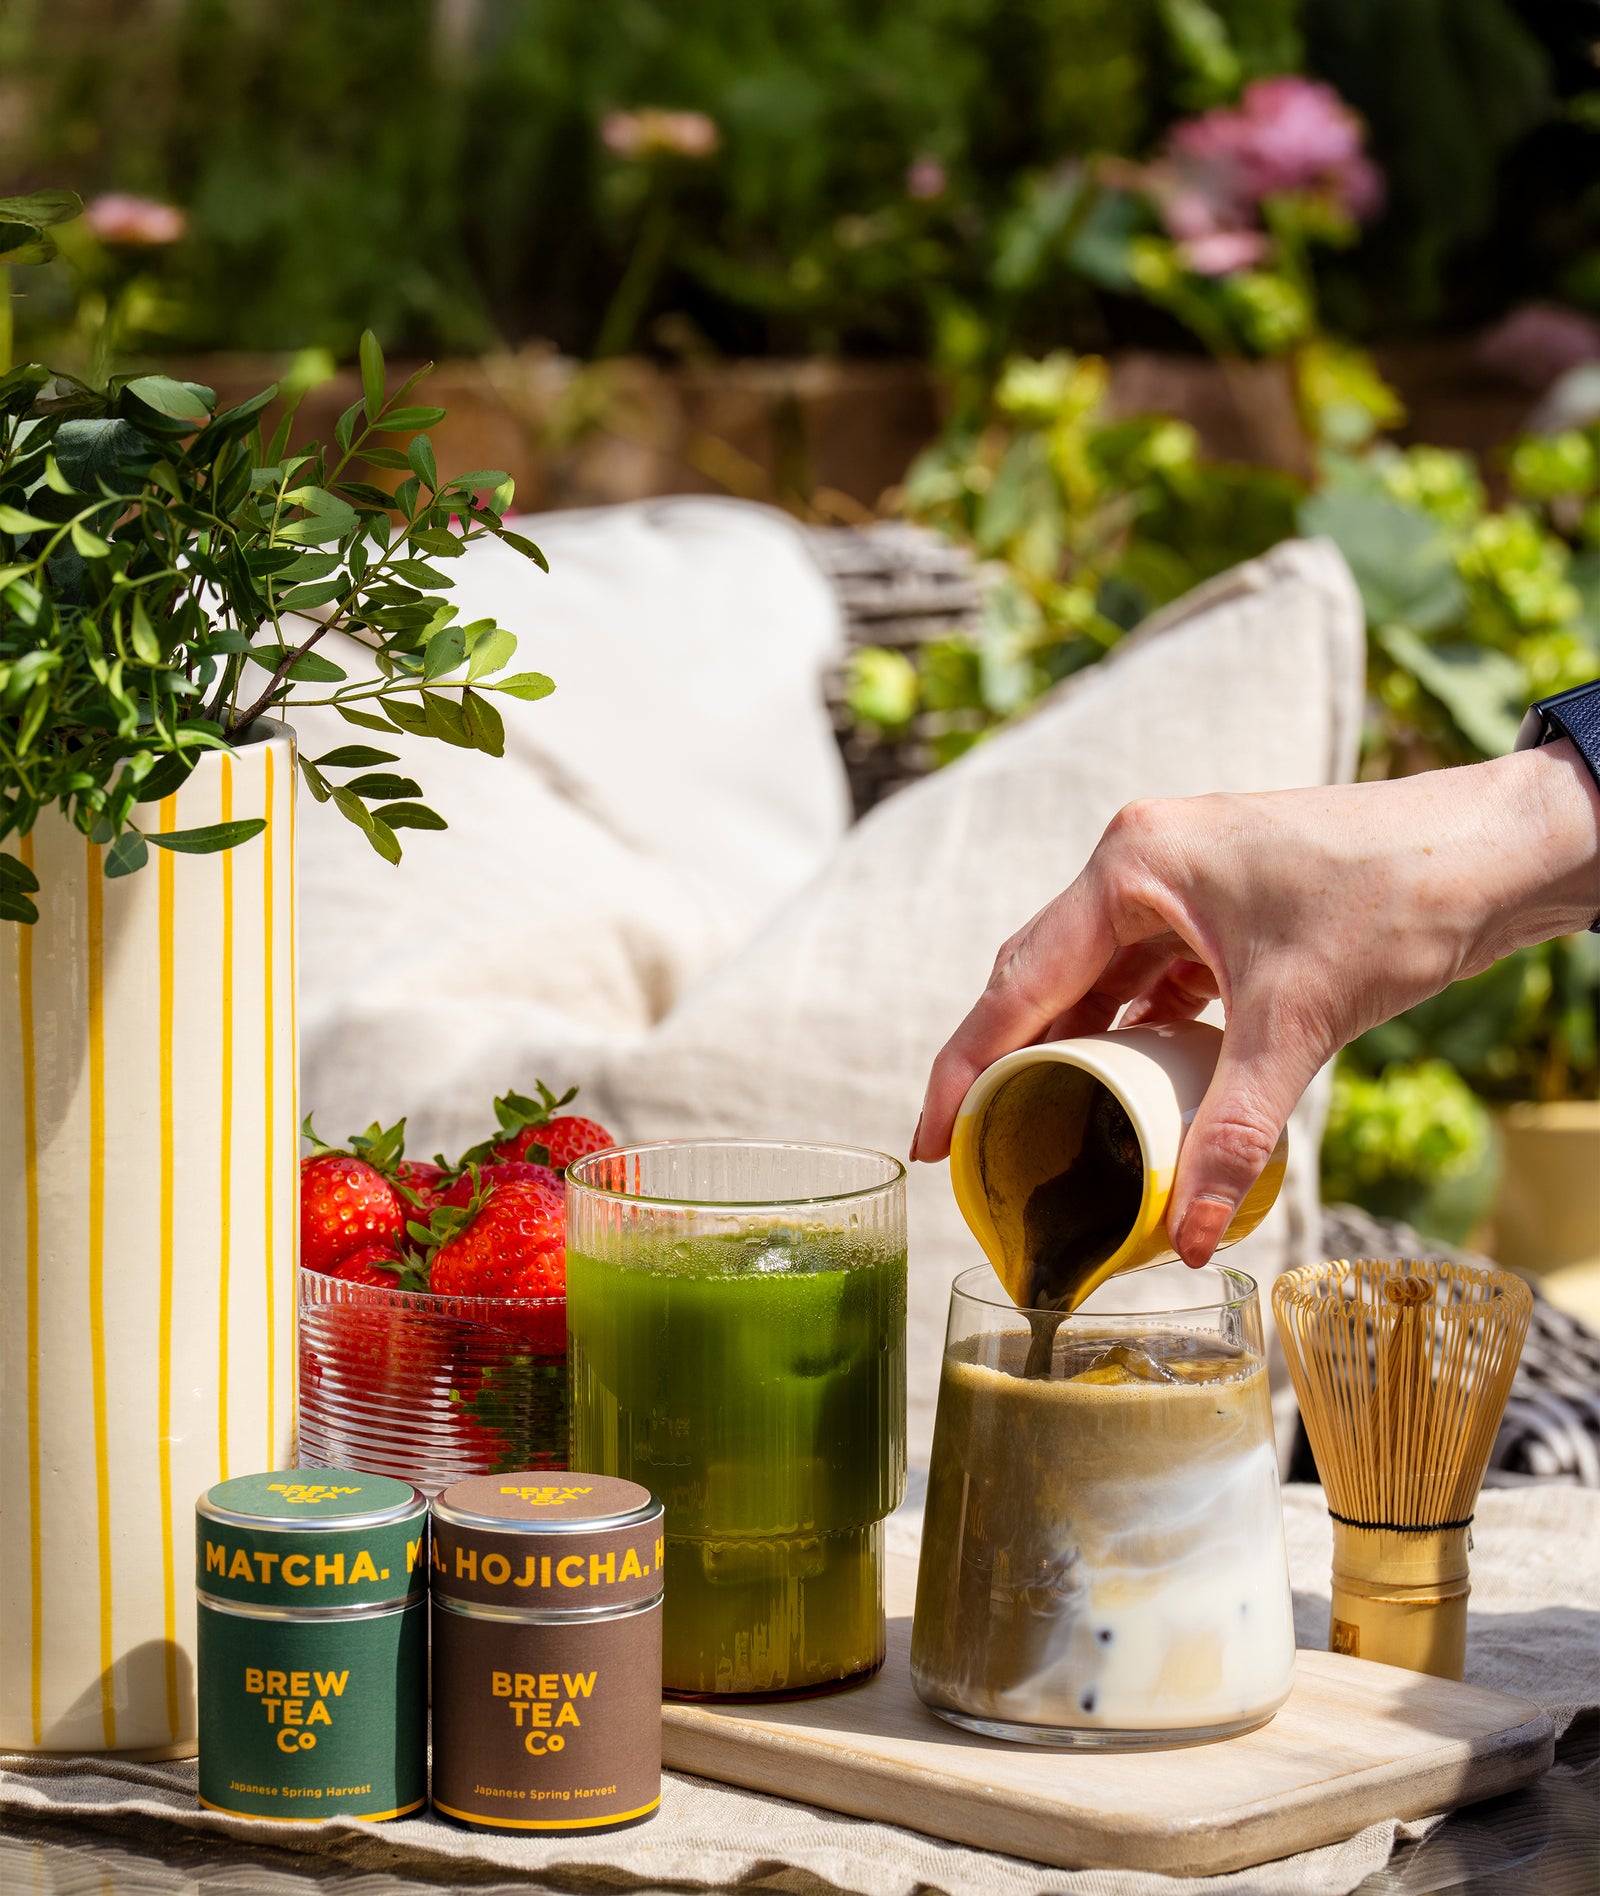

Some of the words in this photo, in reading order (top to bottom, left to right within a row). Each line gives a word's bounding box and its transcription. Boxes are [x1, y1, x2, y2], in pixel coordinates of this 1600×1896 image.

[267, 1483, 361, 1495] BREW
[280, 1489, 338, 1500] TEA
[499, 1486, 593, 1495] BREW
[206, 1540, 390, 1587] MATCHA.
[455, 1547, 650, 1588] HOJICHA.
[245, 1667, 350, 1698] BREW
[492, 1671, 598, 1700] BREW
[261, 1698, 333, 1726] TEA
[508, 1701, 581, 1728] TEA
[276, 1727, 317, 1754] Co
[524, 1730, 566, 1757] Co
[230, 1780, 278, 1796] Japanese
[281, 1786, 322, 1799] Spring
[326, 1784, 371, 1797] Harvest
[473, 1784, 526, 1799] Japanese
[530, 1789, 571, 1801] Spring
[574, 1784, 617, 1799] Harvest
